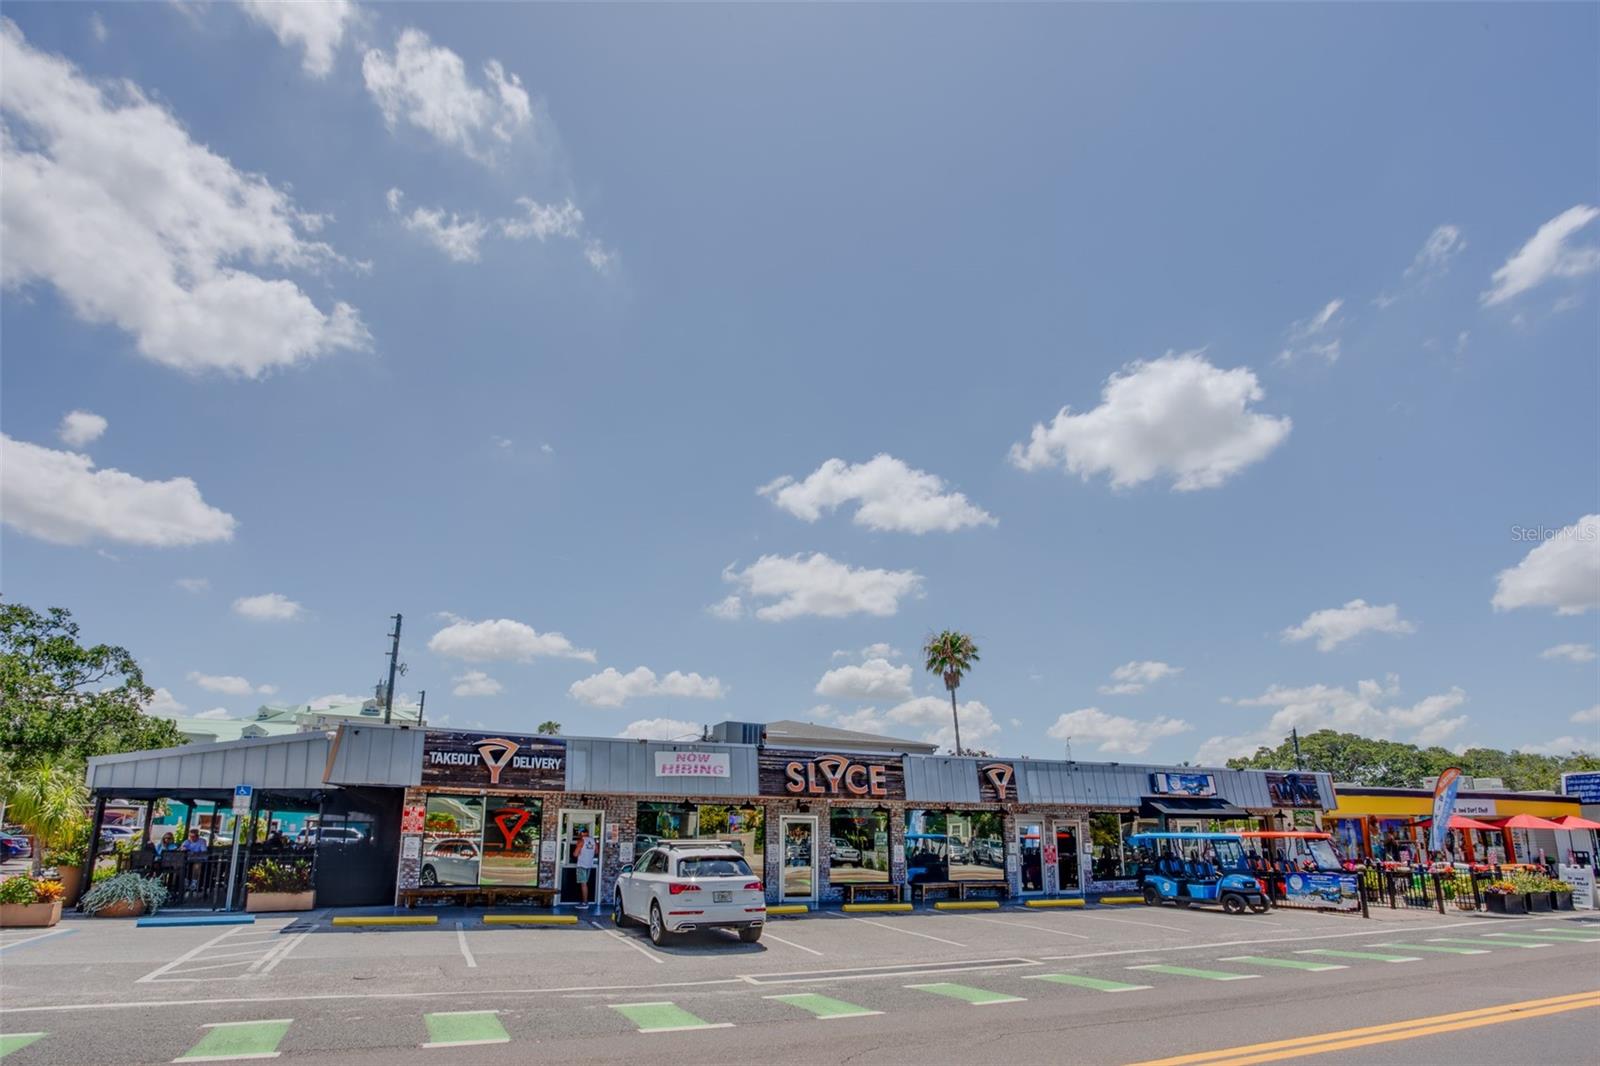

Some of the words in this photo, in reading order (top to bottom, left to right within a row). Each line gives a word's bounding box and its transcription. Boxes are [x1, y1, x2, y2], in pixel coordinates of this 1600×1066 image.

[429, 751, 480, 766] TAKEOUT
[513, 756, 562, 770] DELIVERY
[676, 753, 711, 762] NOW
[661, 764, 724, 775] HIRING
[786, 755, 887, 795] SLYCE
